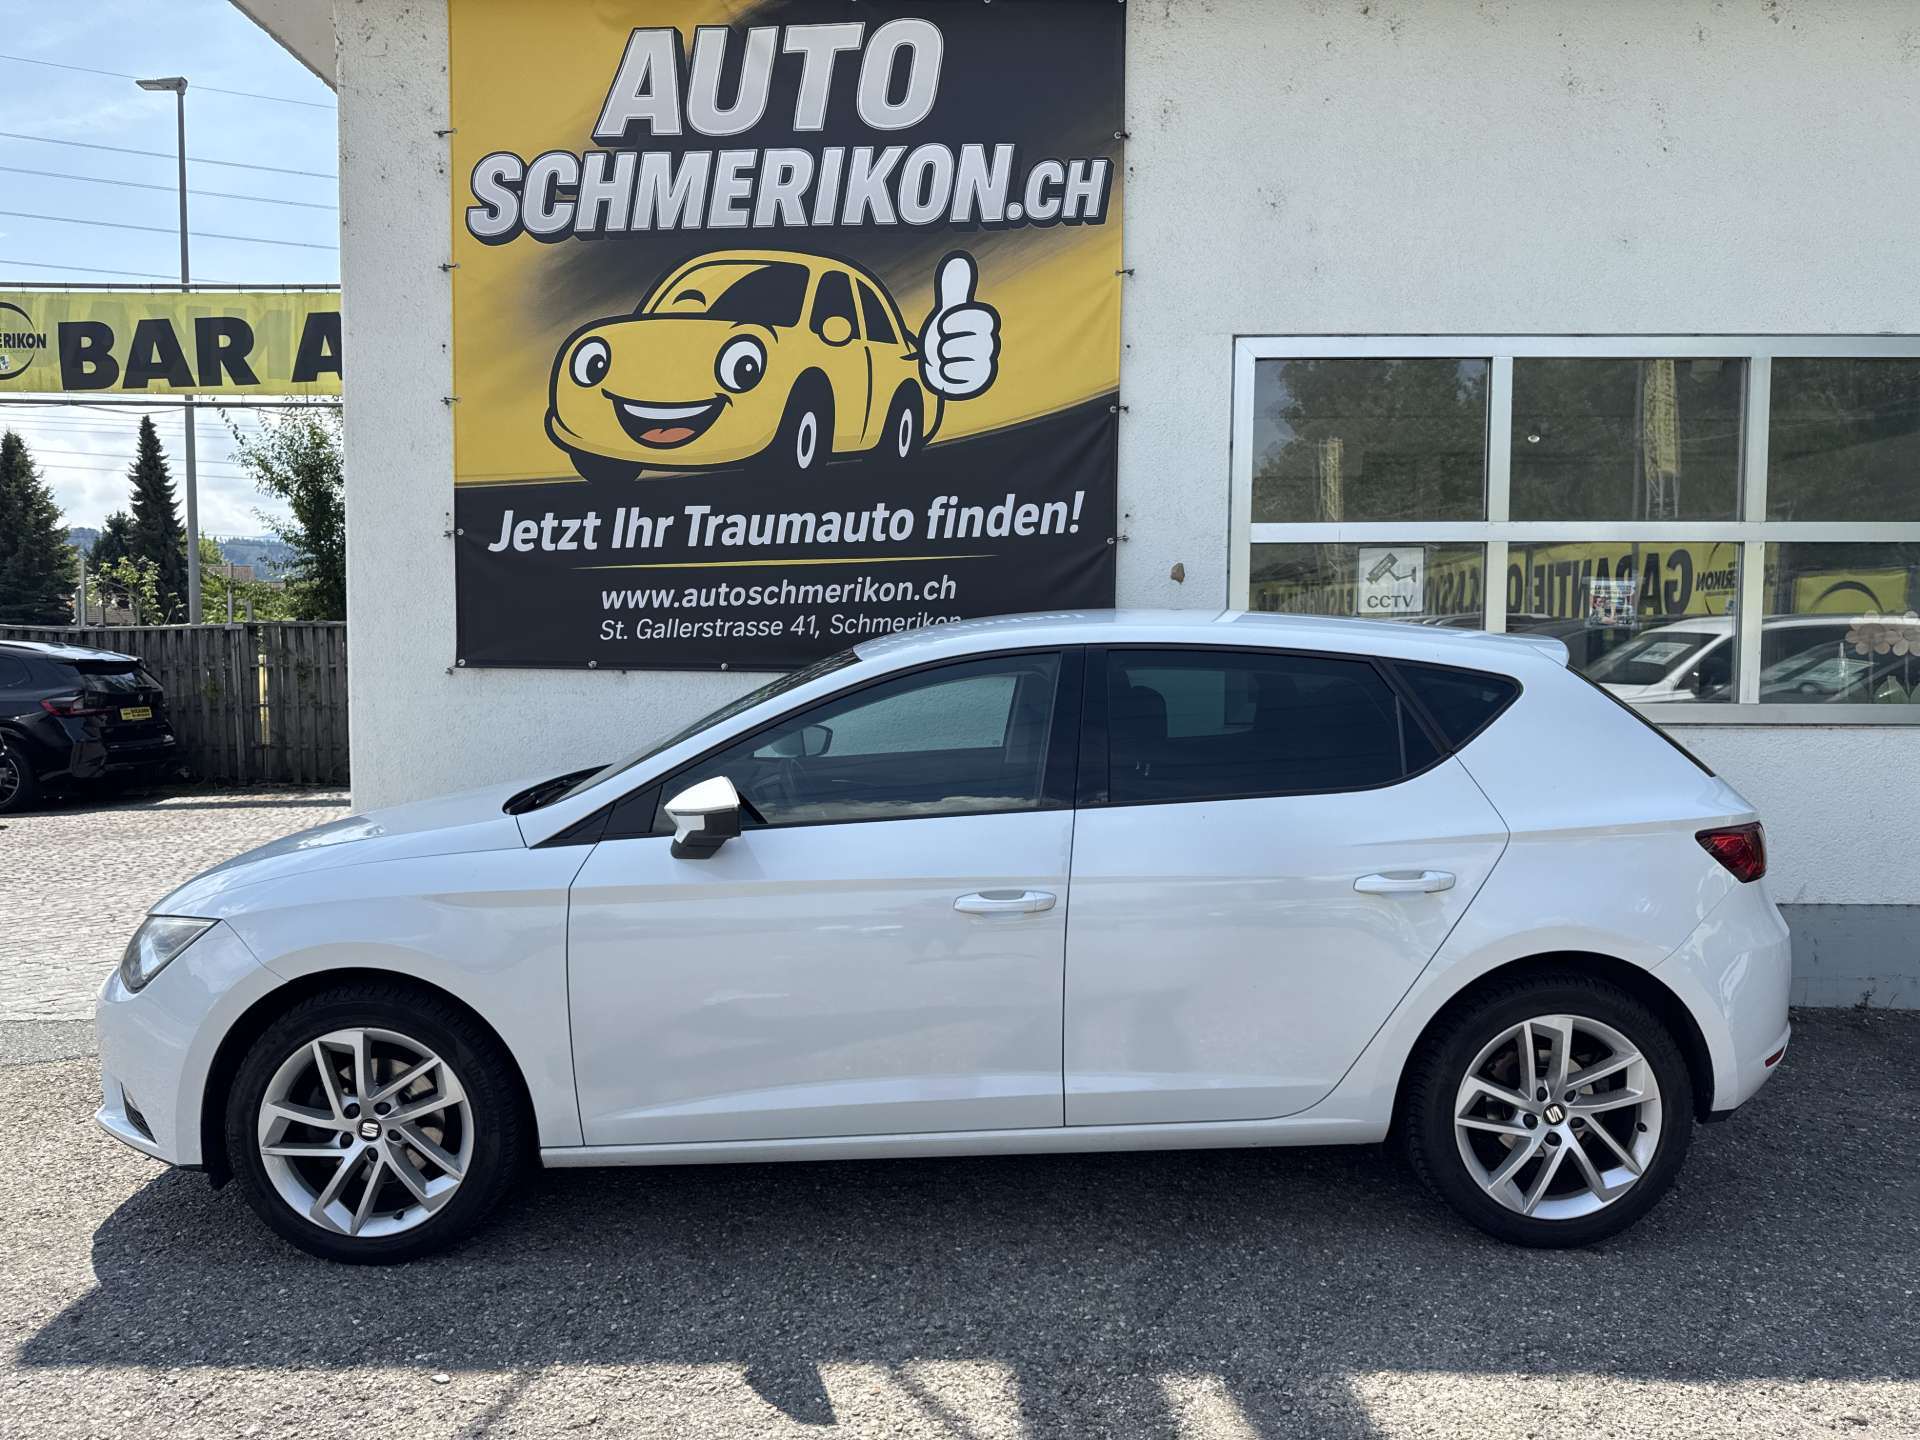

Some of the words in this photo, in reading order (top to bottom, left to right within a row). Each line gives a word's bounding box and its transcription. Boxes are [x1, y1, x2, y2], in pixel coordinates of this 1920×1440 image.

[592, 17, 944, 139] AUTO
[466, 143, 1110, 236] SCHMERIKON.CH
[58, 316, 261, 391] BAR
[488, 510, 601, 552] Jetzt
[611, 507, 674, 549] Ihr
[684, 503, 914, 548] Traumauto
[926, 490, 1085, 540] finden!
[601, 574, 957, 610] www.autoschmerikon.ch
[1367, 594, 1414, 609] CCTV
[600, 618, 628, 640] St.
[636, 617, 783, 640] Gallerstrasse
[790, 614, 820, 639] 41,
